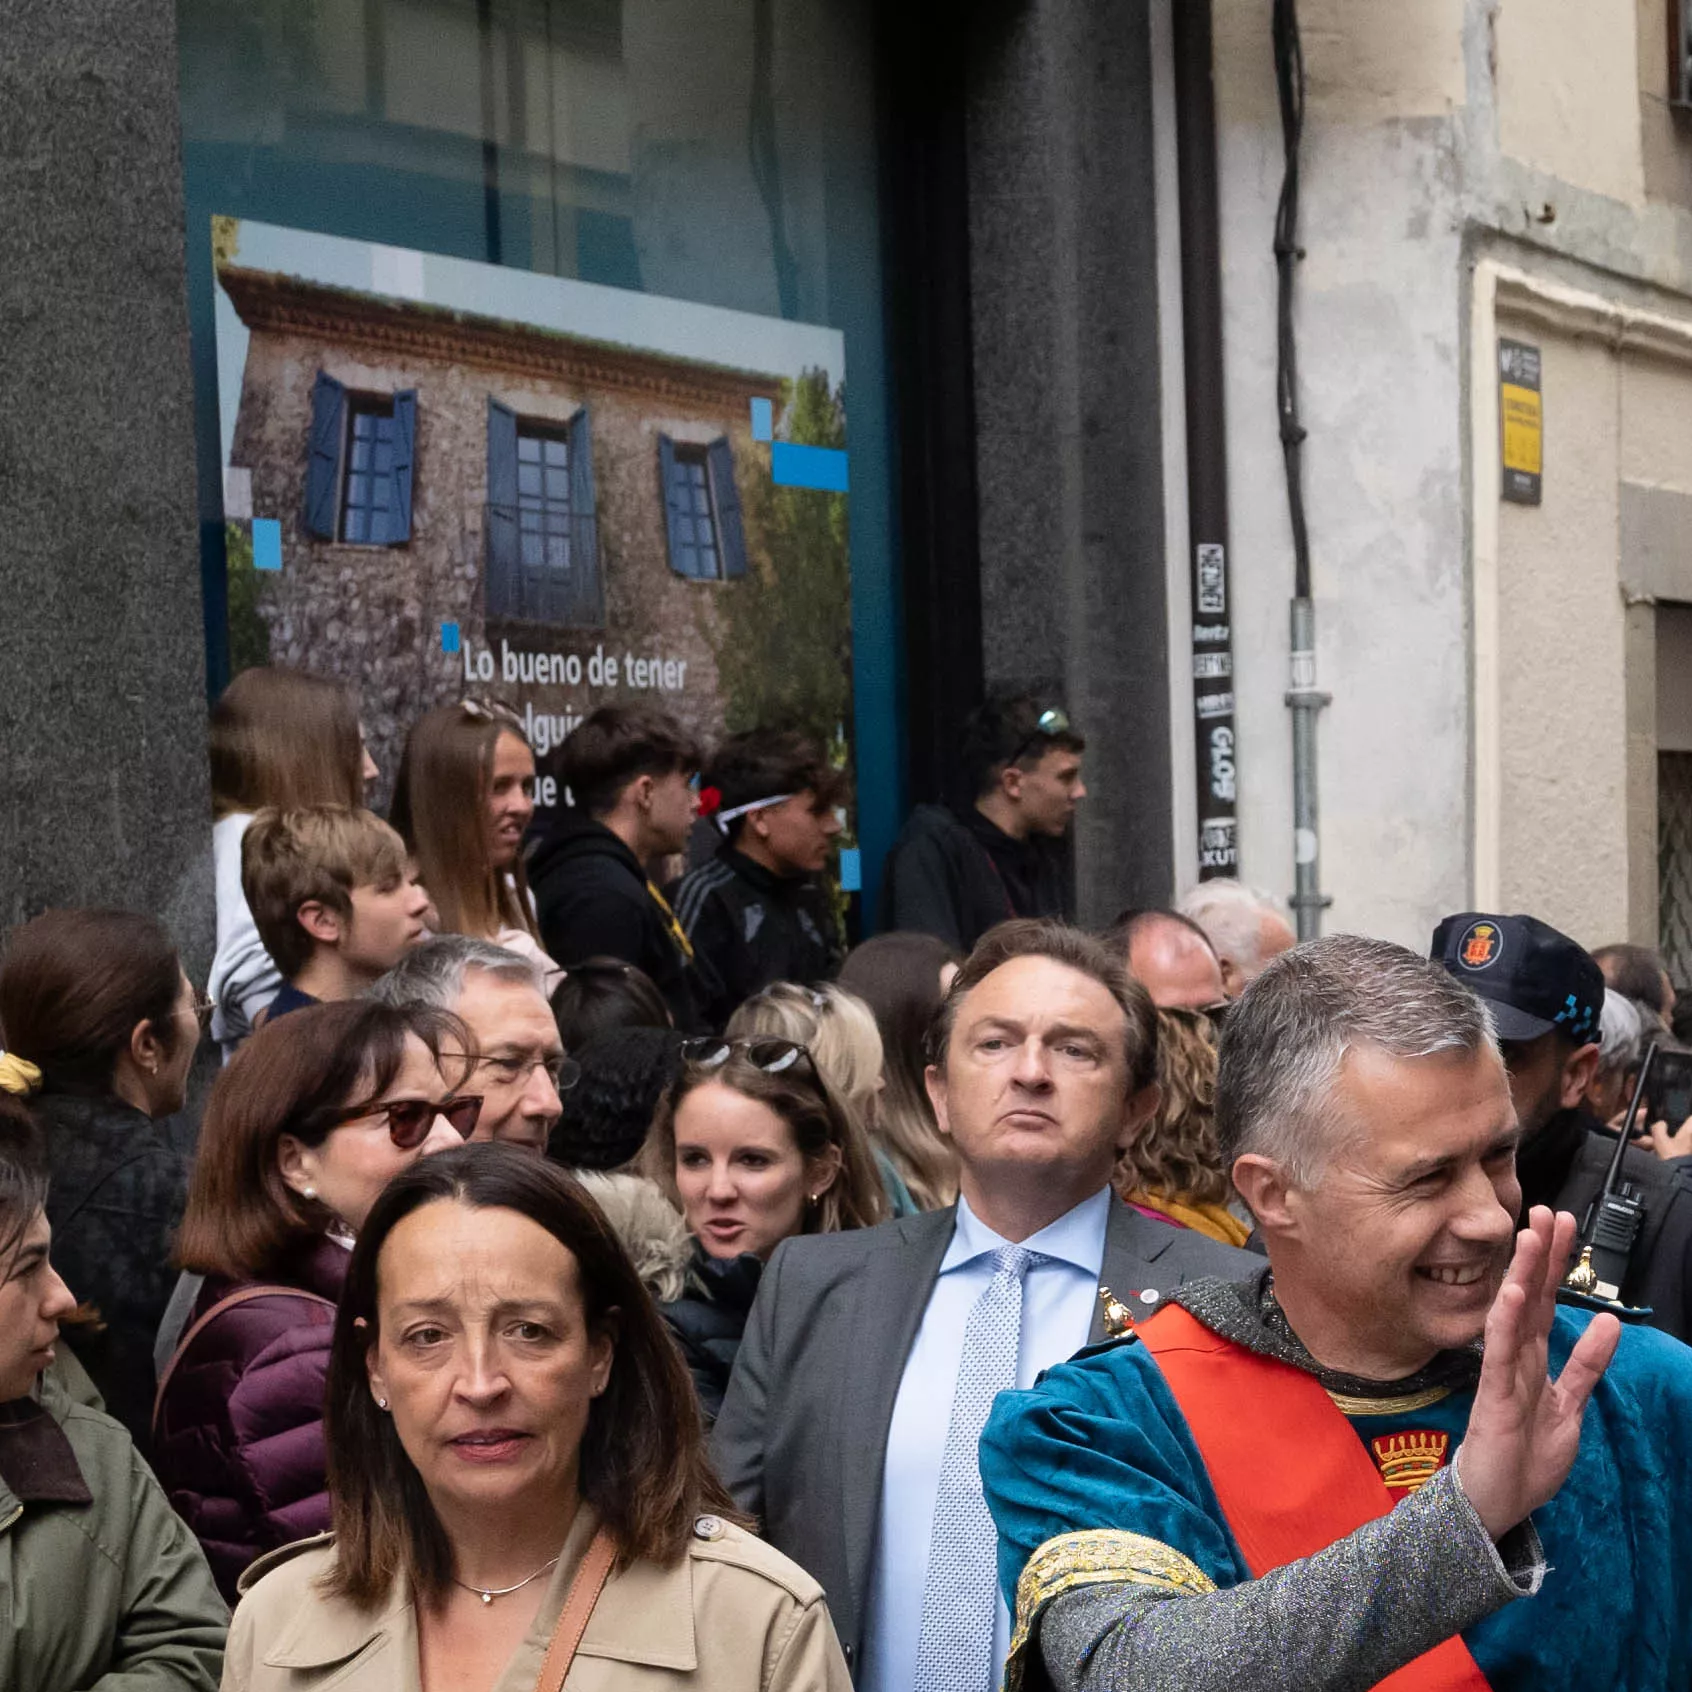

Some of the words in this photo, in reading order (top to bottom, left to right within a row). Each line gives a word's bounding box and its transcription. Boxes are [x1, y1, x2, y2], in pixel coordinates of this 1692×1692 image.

[463, 639, 494, 682] Lo
[502, 638, 581, 684] bueno
[588, 643, 618, 687] de
[625, 651, 687, 690] tener
